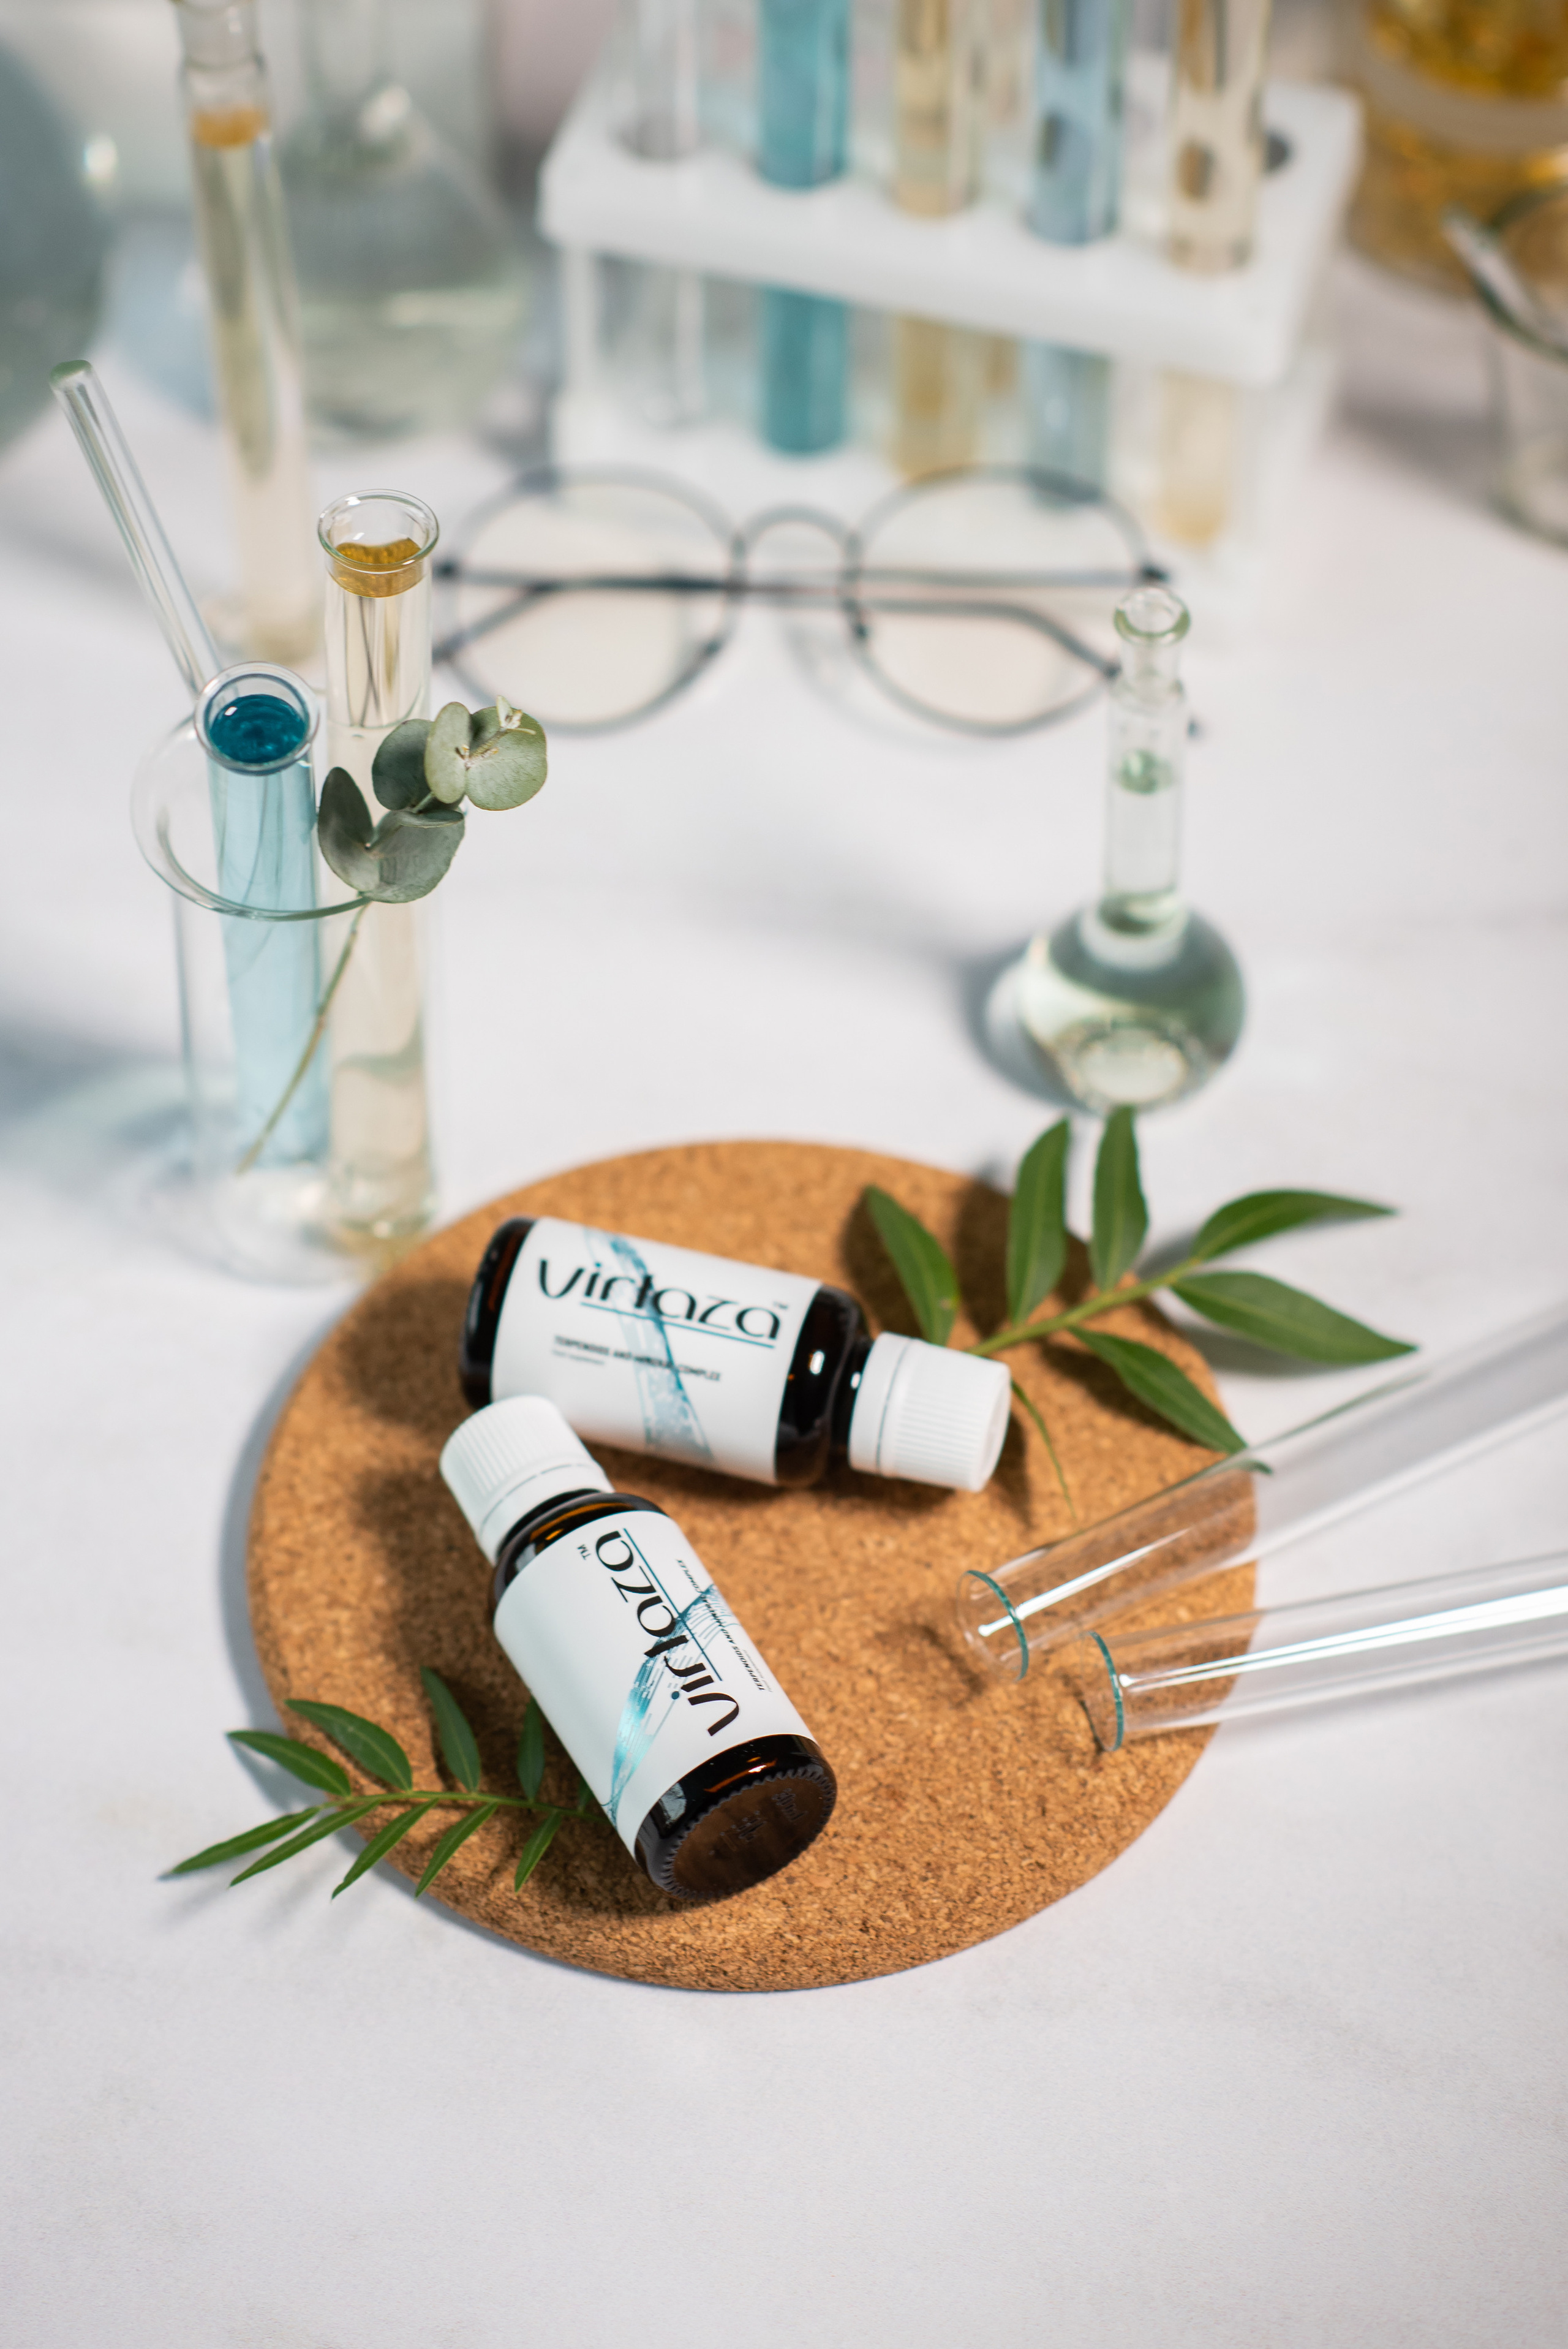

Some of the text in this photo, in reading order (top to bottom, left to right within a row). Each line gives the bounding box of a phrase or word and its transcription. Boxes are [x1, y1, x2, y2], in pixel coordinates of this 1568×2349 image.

[676, 1559, 704, 1594] COMPLEX
[577, 1530, 739, 1737] Virlaza TM
[721, 1628, 736, 1645] AND
[733, 1646, 766, 1691] TERPENOIDS
